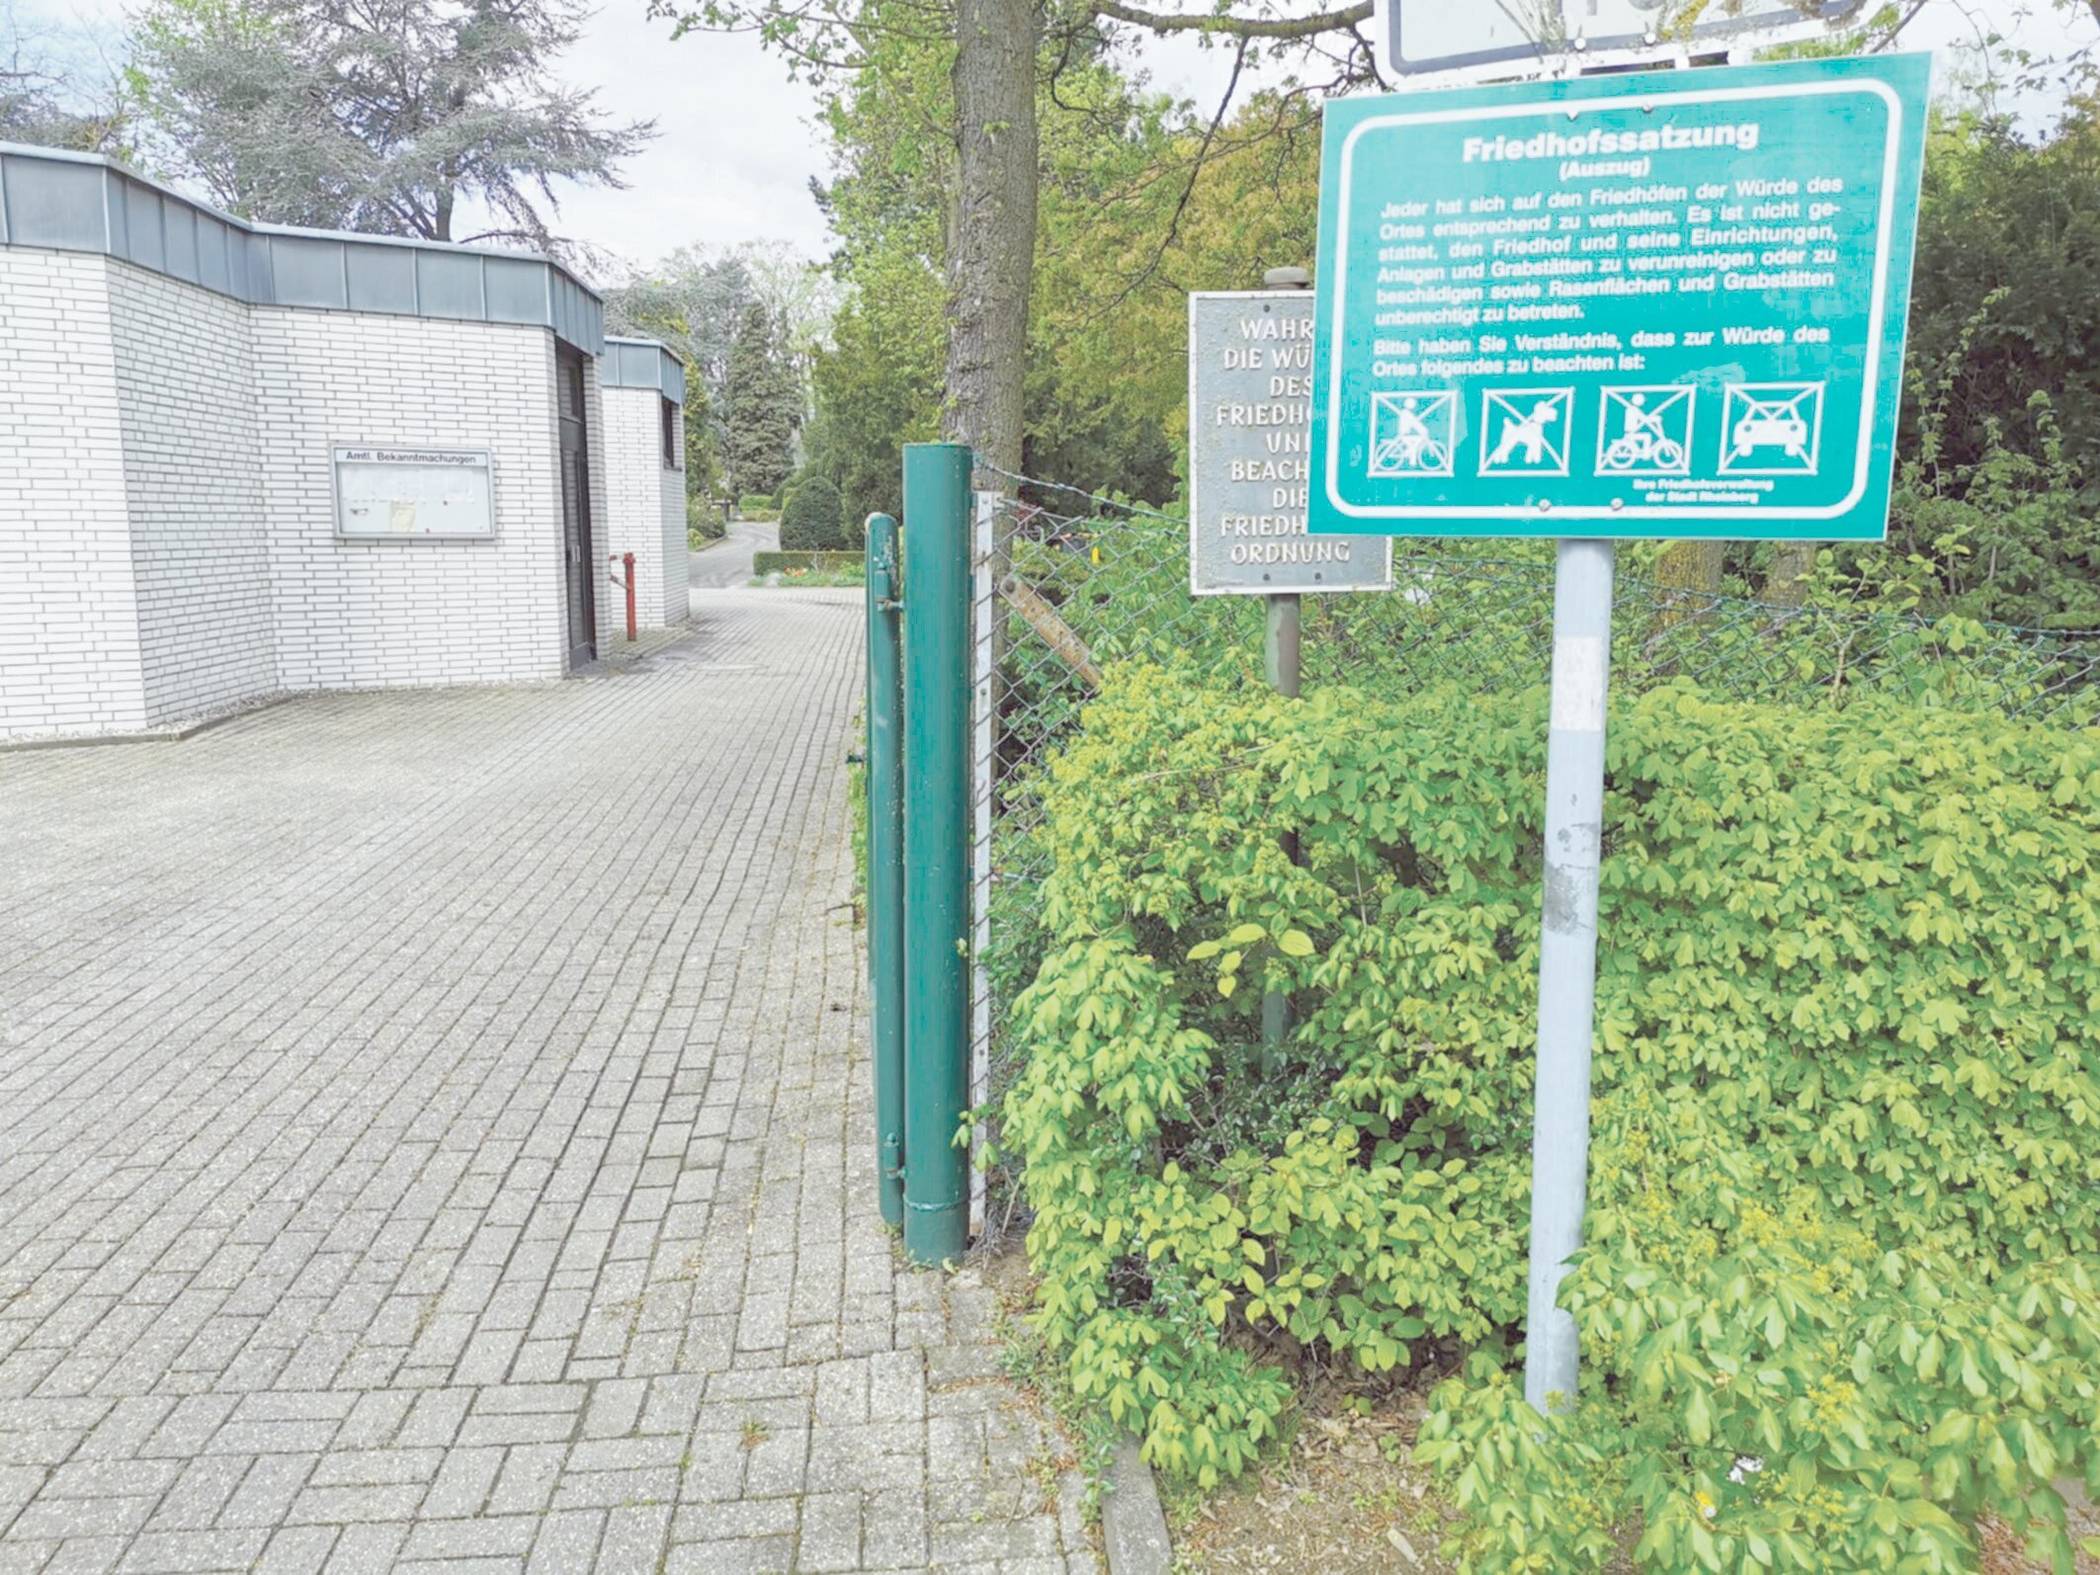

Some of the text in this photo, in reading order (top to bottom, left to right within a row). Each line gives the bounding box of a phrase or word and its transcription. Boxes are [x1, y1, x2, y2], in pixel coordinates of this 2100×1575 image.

[1463, 123, 1759, 163] Friedhofssatzung
[1559, 156, 1650, 181] (Auszug)
[1381, 176, 1843, 218] Jeder hat sich auf den Friedhöfen der Würde des
[1379, 200, 1841, 240] Ortes entsprechend zu verhalten. Es ist nicht ge-
[1449, 240, 1483, 258] den
[1493, 235, 1572, 256] Friedhof
[1581, 232, 1618, 251] und
[1626, 230, 1681, 249] seine
[1691, 224, 1839, 247] Einrichtungen,
[1377, 248, 1837, 285] Anlagen und Grabstätten zu verunreinigen oder zu
[1376, 270, 1835, 305] beschädigen sowie Rasenflächen und Grabstätten
[1375, 302, 1585, 327] unberechtigt zu betreten.
[1240, 319, 1313, 341] WAHR
[1373, 325, 1830, 356] Bitte haben Sie Verständnis, dass zur Würde des
[1223, 347, 1263, 370] DIE
[1372, 352, 1646, 378] Ortes folgendes zu beachten ist:
[1269, 376, 1313, 397] DES
[1265, 431, 1310, 453] UN
[377, 451, 477, 465] Bekanntmachungen
[1231, 460, 1307, 482] BEACH
[1221, 515, 1306, 537] FRIEDH
[1230, 543, 1350, 564] ORDNUNG
